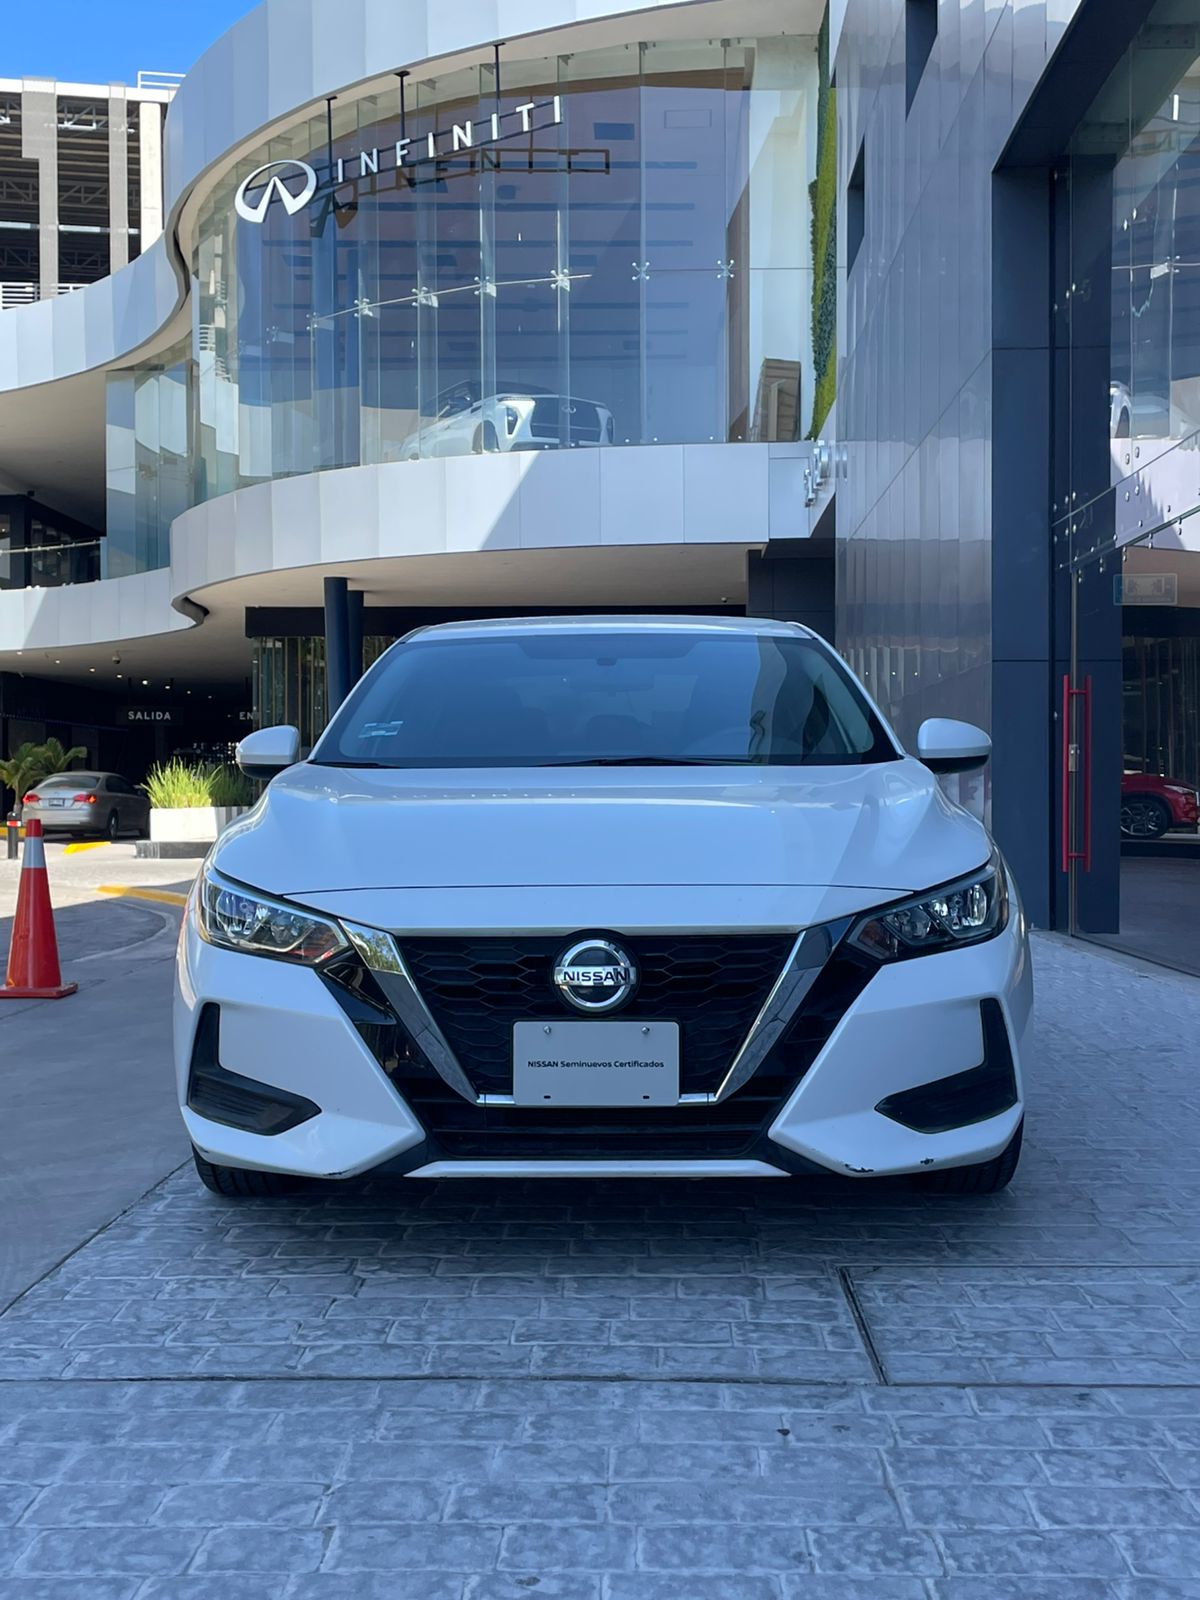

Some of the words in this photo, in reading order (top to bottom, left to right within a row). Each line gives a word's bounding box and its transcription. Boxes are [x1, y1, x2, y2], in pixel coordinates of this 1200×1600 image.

[336, 95, 562, 183] INFINITI
[128, 711, 171, 720] SALIDA
[563, 970, 627, 982] NISSAN
[527, 1060, 559, 1068] NISSAN
[560, 1060, 613, 1068] Seminuevos
[613, 1060, 665, 1068] Certificados
